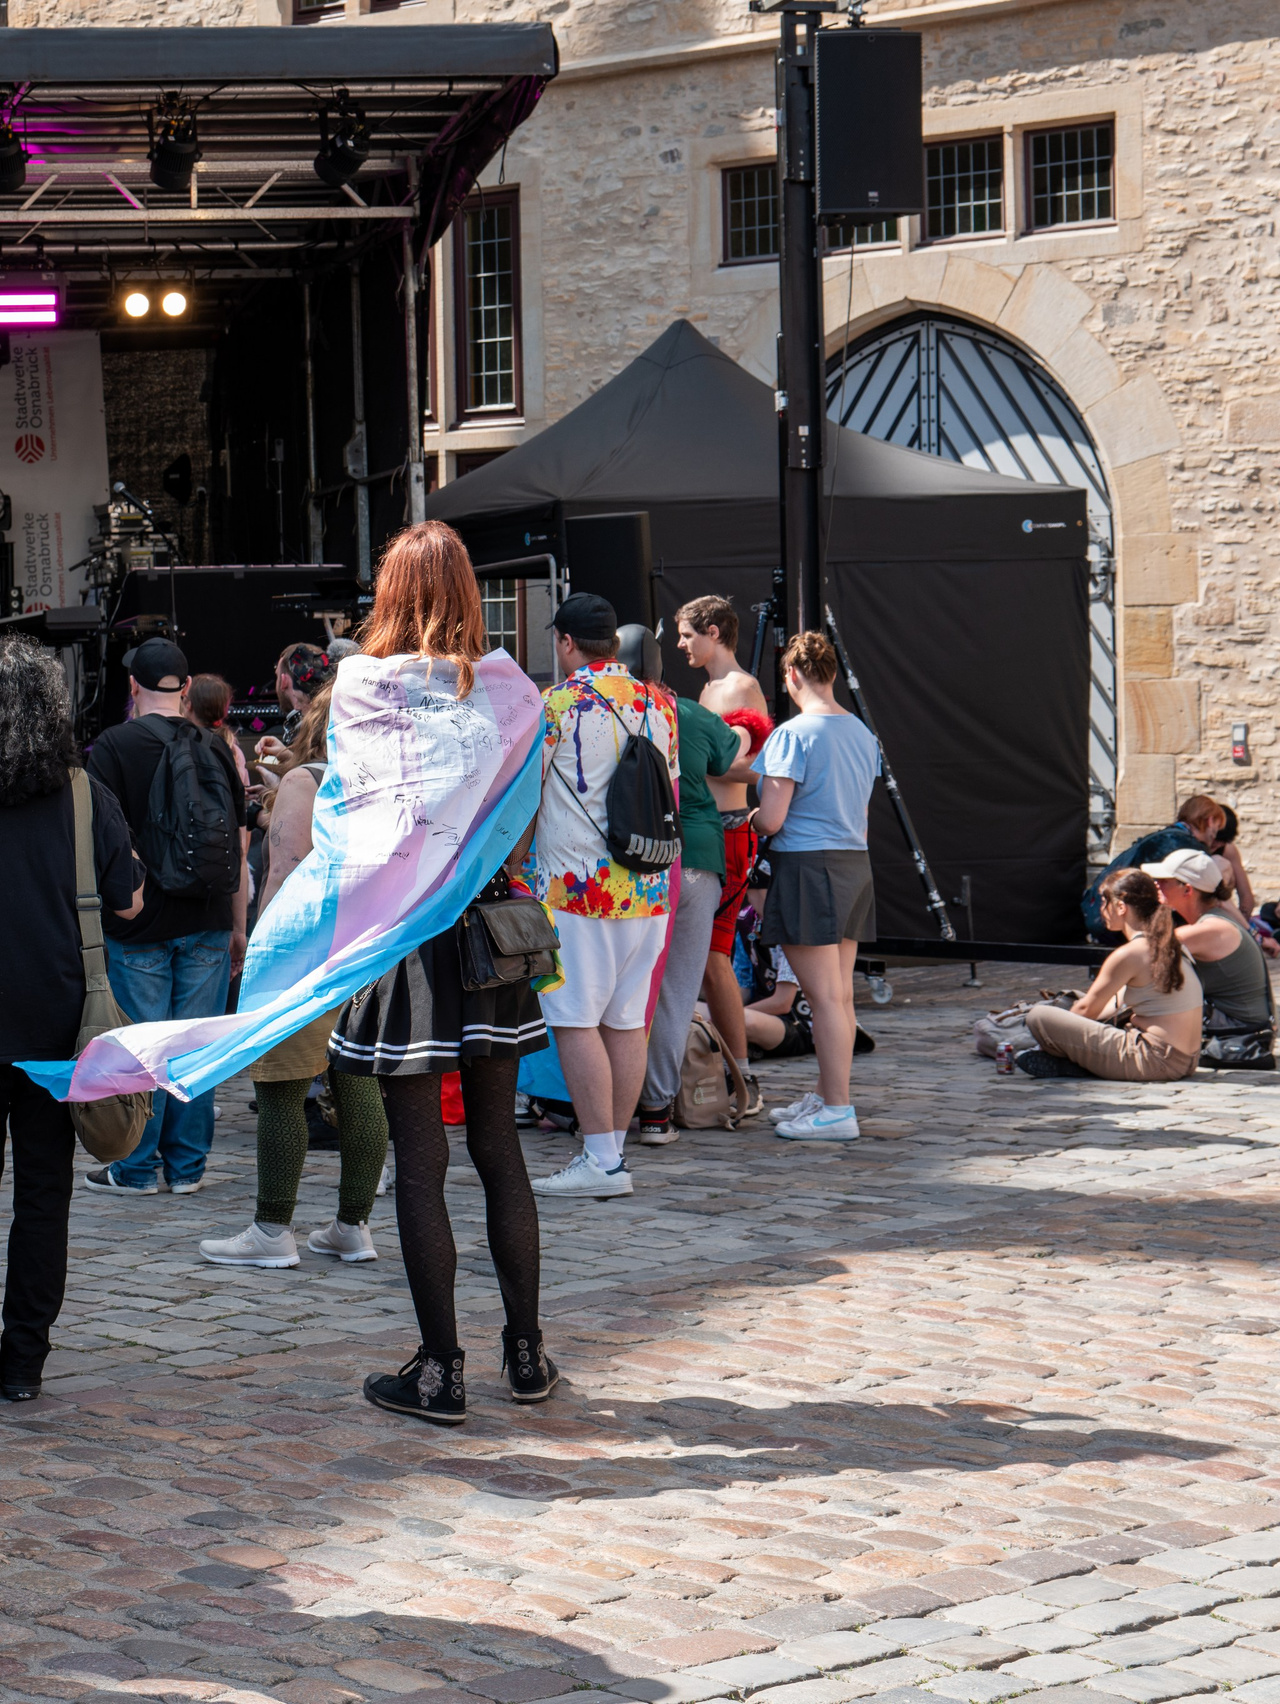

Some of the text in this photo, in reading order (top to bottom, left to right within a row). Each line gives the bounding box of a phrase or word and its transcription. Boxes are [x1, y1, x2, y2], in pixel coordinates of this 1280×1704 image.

[12, 347, 28, 429] Stadtwerke
[25, 347, 43, 429] Osnabrück
[22, 512, 38, 598] Stadtwerke
[36, 512, 52, 597] Osnabrück
[361, 676, 392, 693] Hannah
